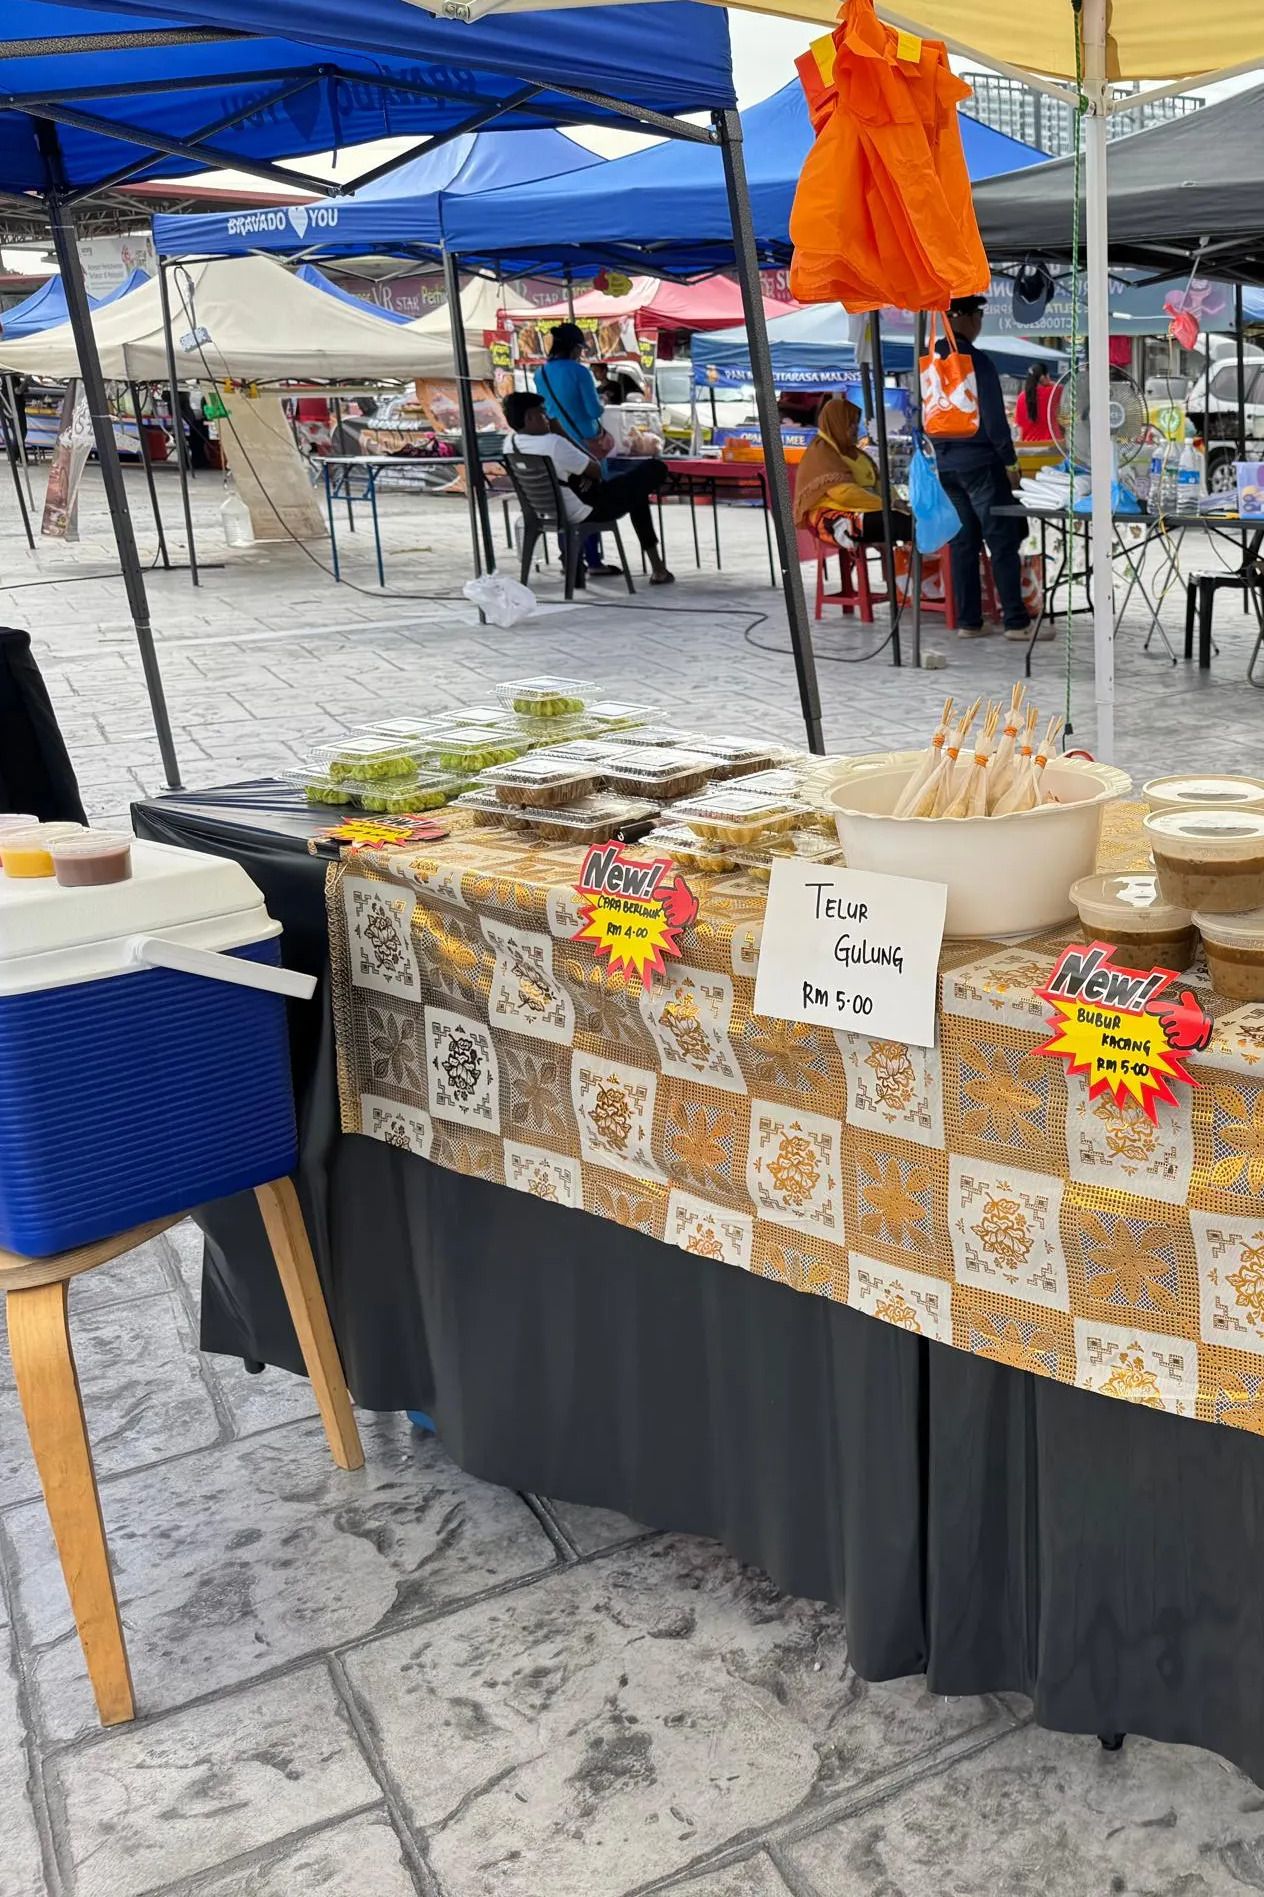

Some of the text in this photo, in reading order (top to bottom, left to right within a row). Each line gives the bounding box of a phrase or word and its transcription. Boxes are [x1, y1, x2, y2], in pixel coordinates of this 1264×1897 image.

[227, 208, 339, 236] BRAVADO YOU
[372, 283, 393, 311] VR
[396, 296, 420, 311] STAR
[582, 846, 664, 898] New!
[606, 922, 622, 937] RM
[1048, 948, 1166, 1012] New!
[1076, 1008, 1121, 1030] BUBUR
[1101, 1032, 1152, 1057] KACANG
[1096, 1057, 1116, 1072] RM
